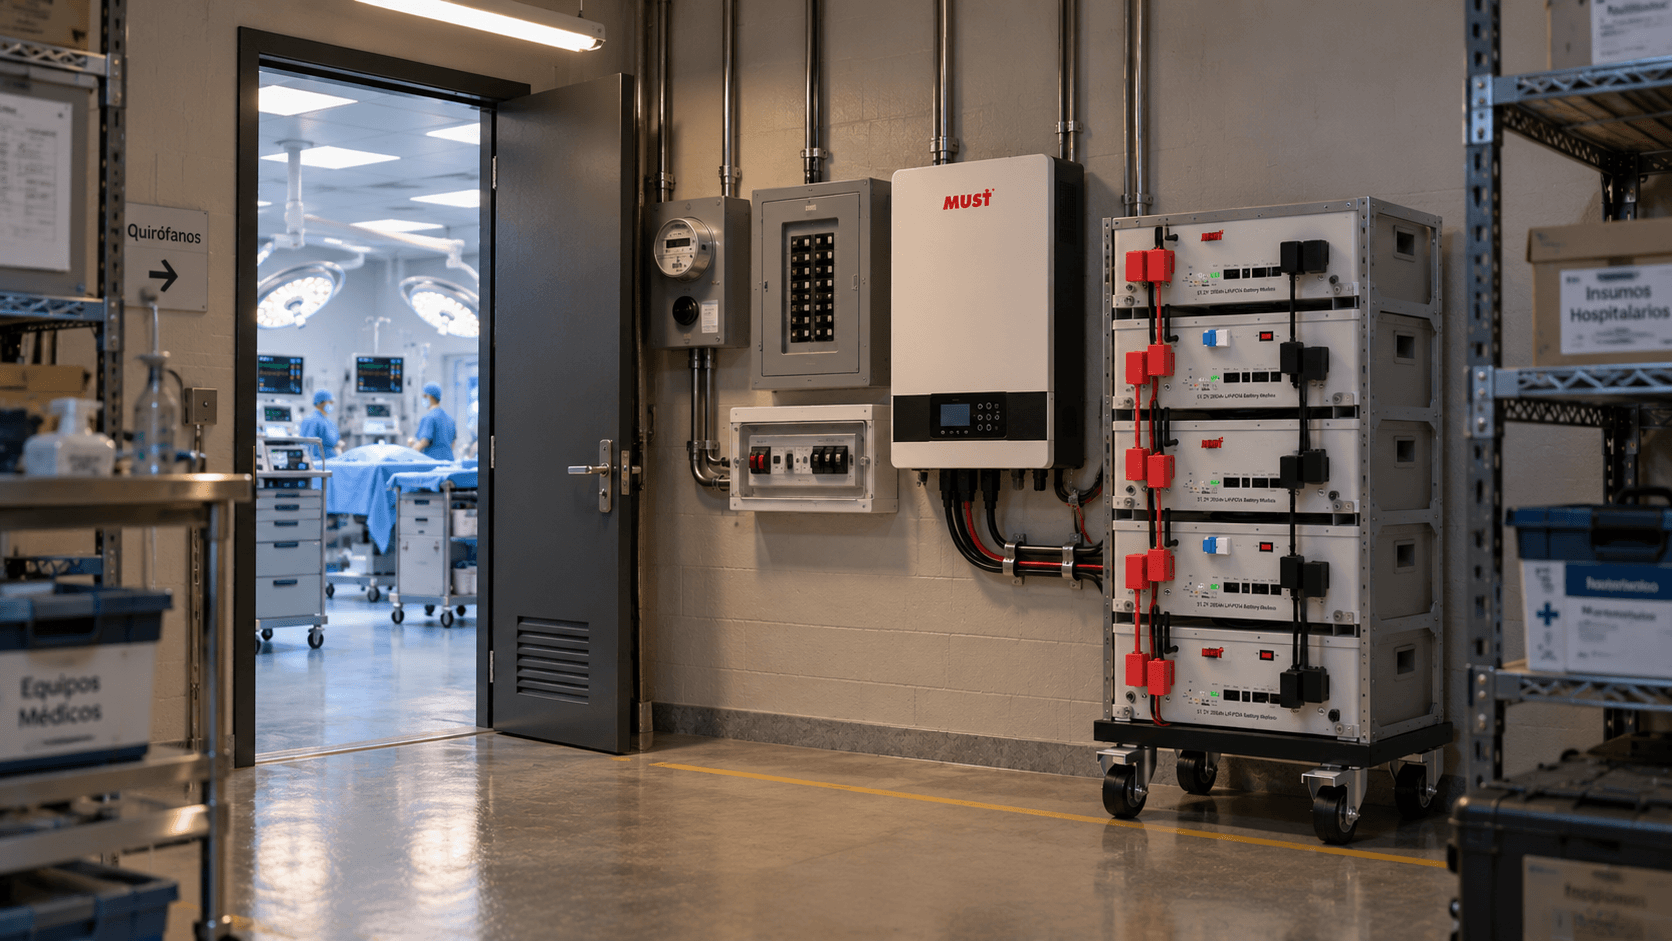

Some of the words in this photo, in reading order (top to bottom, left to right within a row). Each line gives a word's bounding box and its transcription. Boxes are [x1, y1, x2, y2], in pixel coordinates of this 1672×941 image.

[943, 188, 994, 210] MUST
[127, 223, 201, 244] Quirófanos
[1586, 285, 1651, 301] Insumos
[1570, 303, 1670, 324] Hospitalarios
[20, 673, 101, 700] Equipos
[18, 702, 103, 728] Médicos
